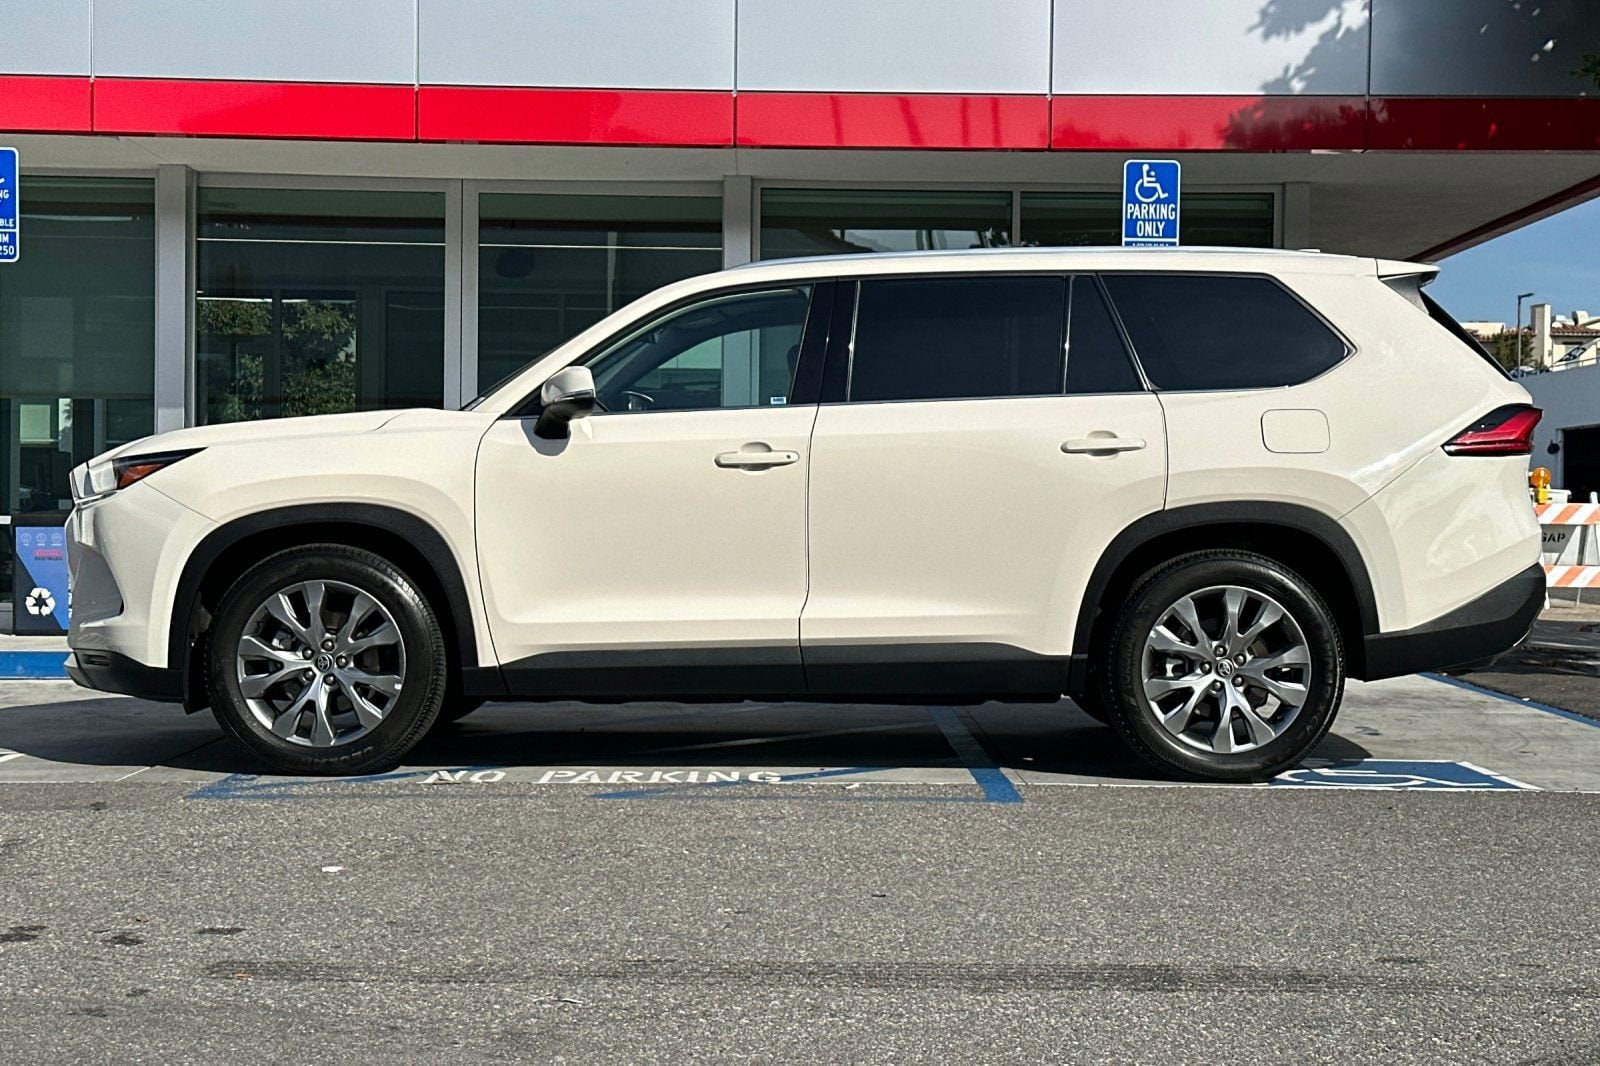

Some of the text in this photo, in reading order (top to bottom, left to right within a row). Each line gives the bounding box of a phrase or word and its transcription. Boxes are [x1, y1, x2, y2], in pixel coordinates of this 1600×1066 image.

[1127, 203, 1176, 220] PARKING
[1136, 220, 1165, 237] ONLY
[424, 770, 782, 784] NO PARKING
